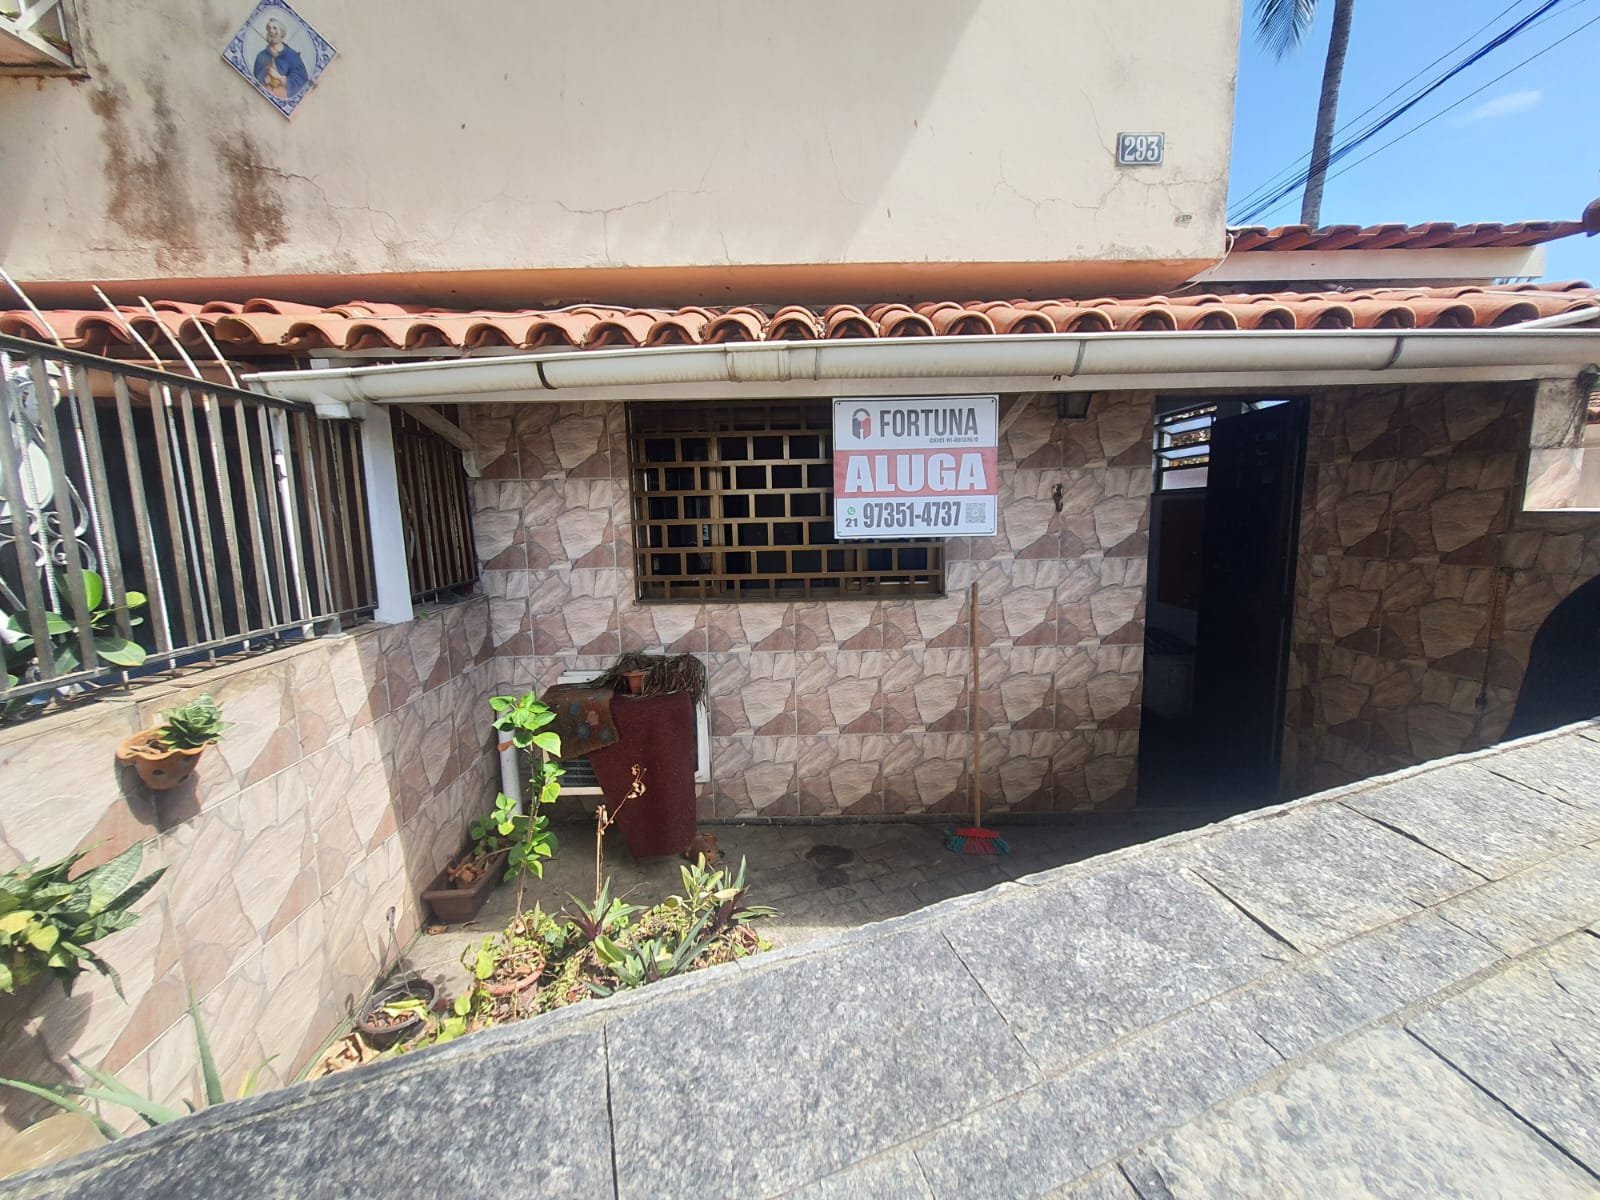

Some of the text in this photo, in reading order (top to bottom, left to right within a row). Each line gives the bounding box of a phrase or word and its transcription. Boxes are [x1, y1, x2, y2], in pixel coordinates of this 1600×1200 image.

[1124, 136, 1159, 161] 293
[879, 408, 978, 438] FORTUNA
[844, 453, 988, 493] ALUGA
[845, 501, 961, 529] 21 97351-4737
